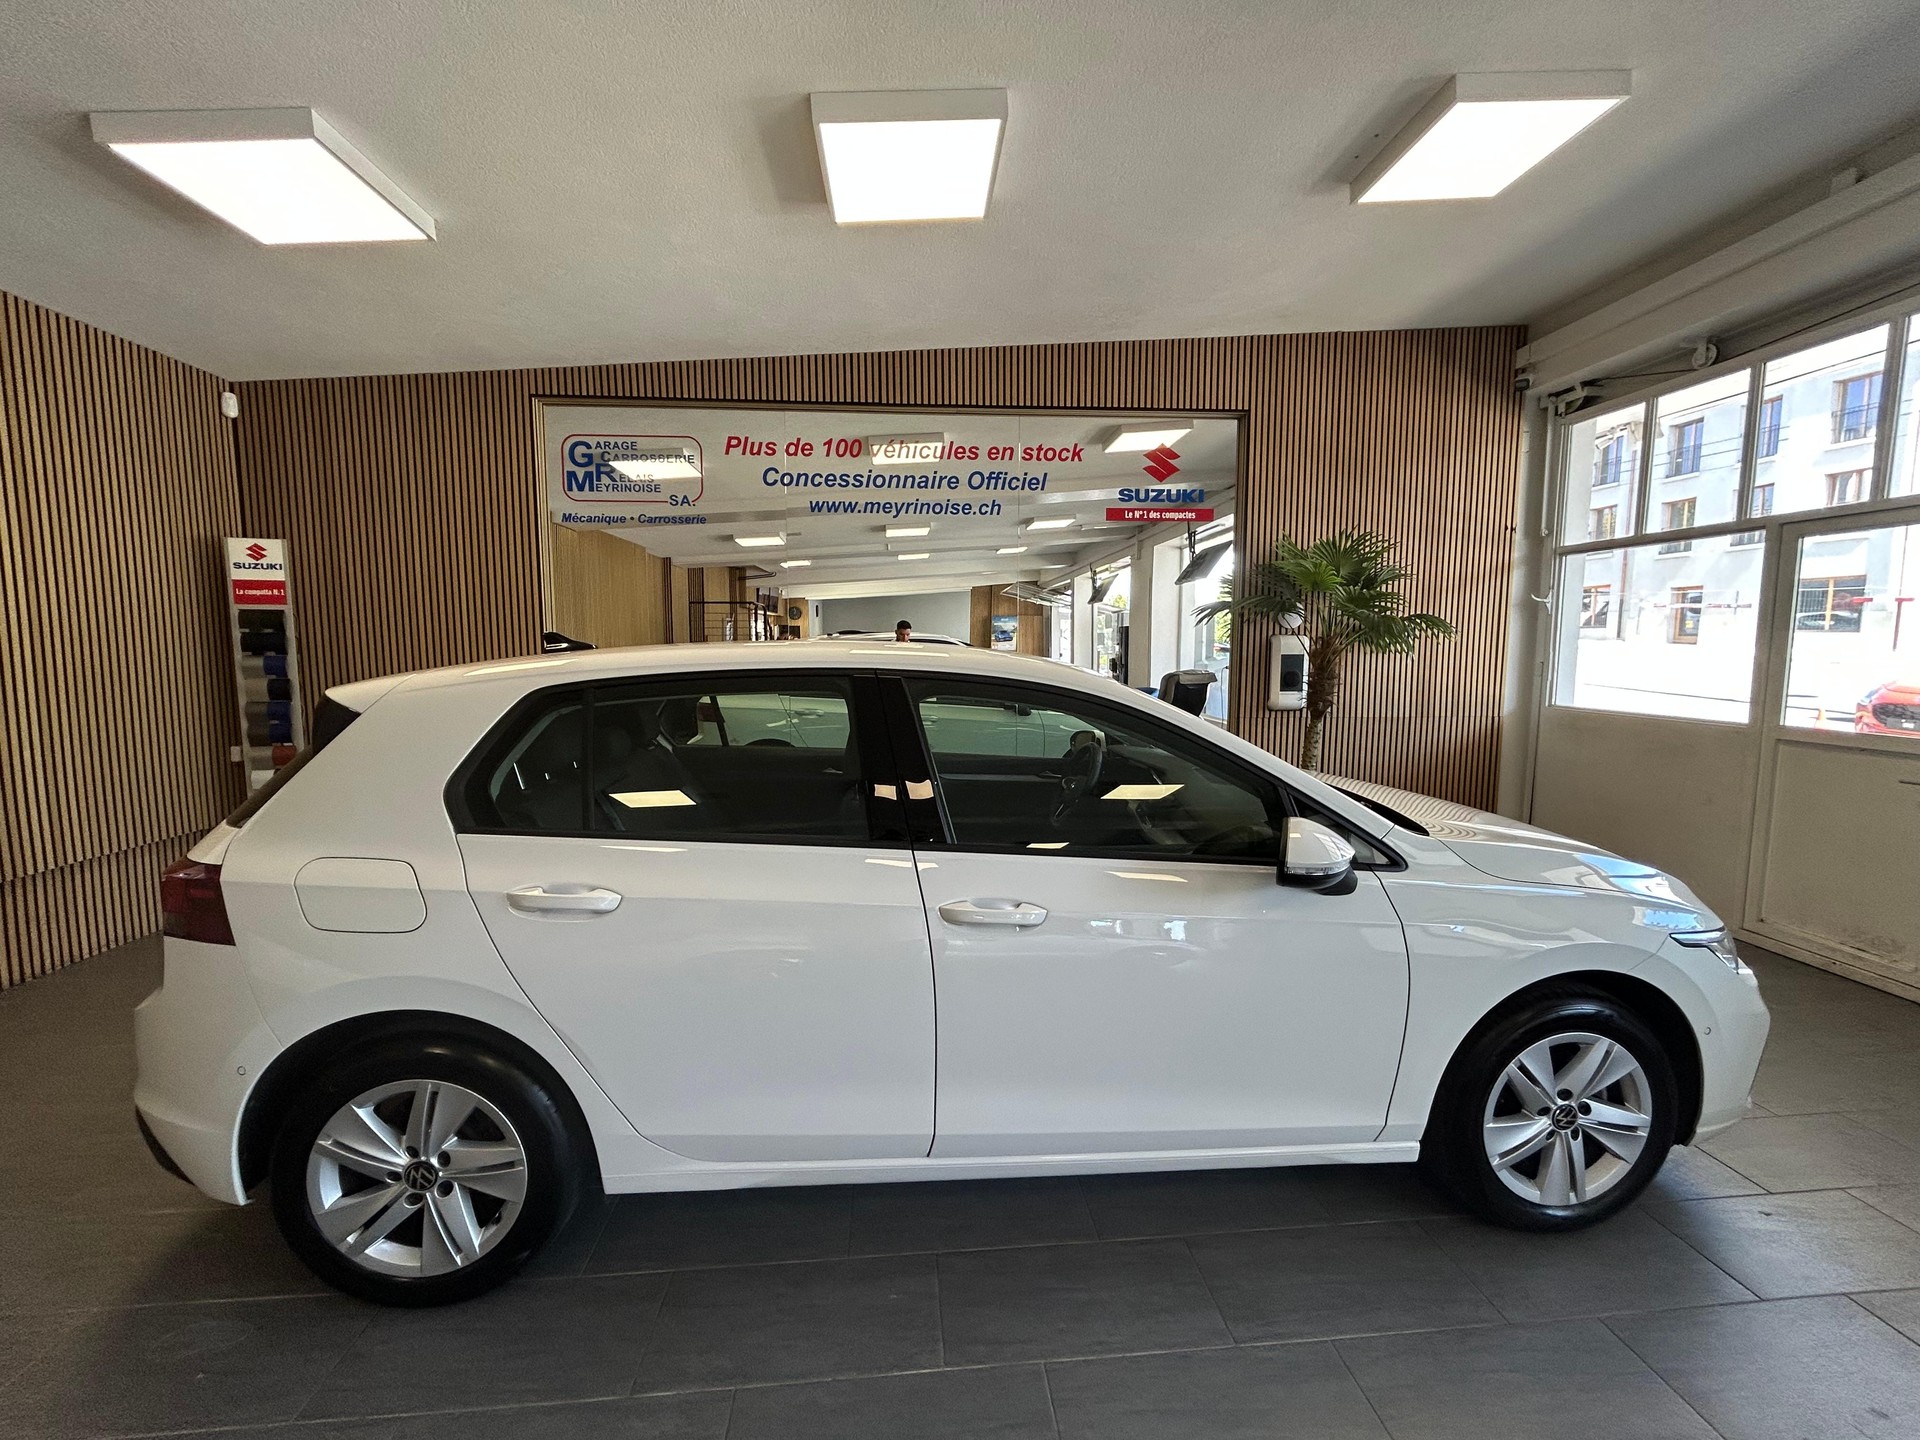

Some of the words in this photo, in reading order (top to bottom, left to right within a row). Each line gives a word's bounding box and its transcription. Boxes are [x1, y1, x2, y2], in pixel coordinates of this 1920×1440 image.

[568, 440, 638, 468] GARAGE
[724, 435, 777, 457] Plus
[785, 437, 814, 457] de
[822, 438, 863, 458] 100
[870, 438, 980, 461] véhicules
[987, 446, 1015, 461] en
[1021, 443, 1085, 462] stock
[566, 470, 662, 493] MEYRINOISE
[762, 467, 960, 490] Concessionnaire
[967, 470, 1049, 491] Officiel
[1118, 488, 1205, 503] SUZUKI
[561, 512, 627, 526] Mécanique
[637, 513, 707, 525] Carrosserie
[809, 499, 1002, 519] www.meyrinoise.ch
[1124, 510, 1133, 519] Le
[1149, 510, 1161, 519] des
[1161, 510, 1196, 521] compactes
[233, 562, 283, 570] SUZUKI
